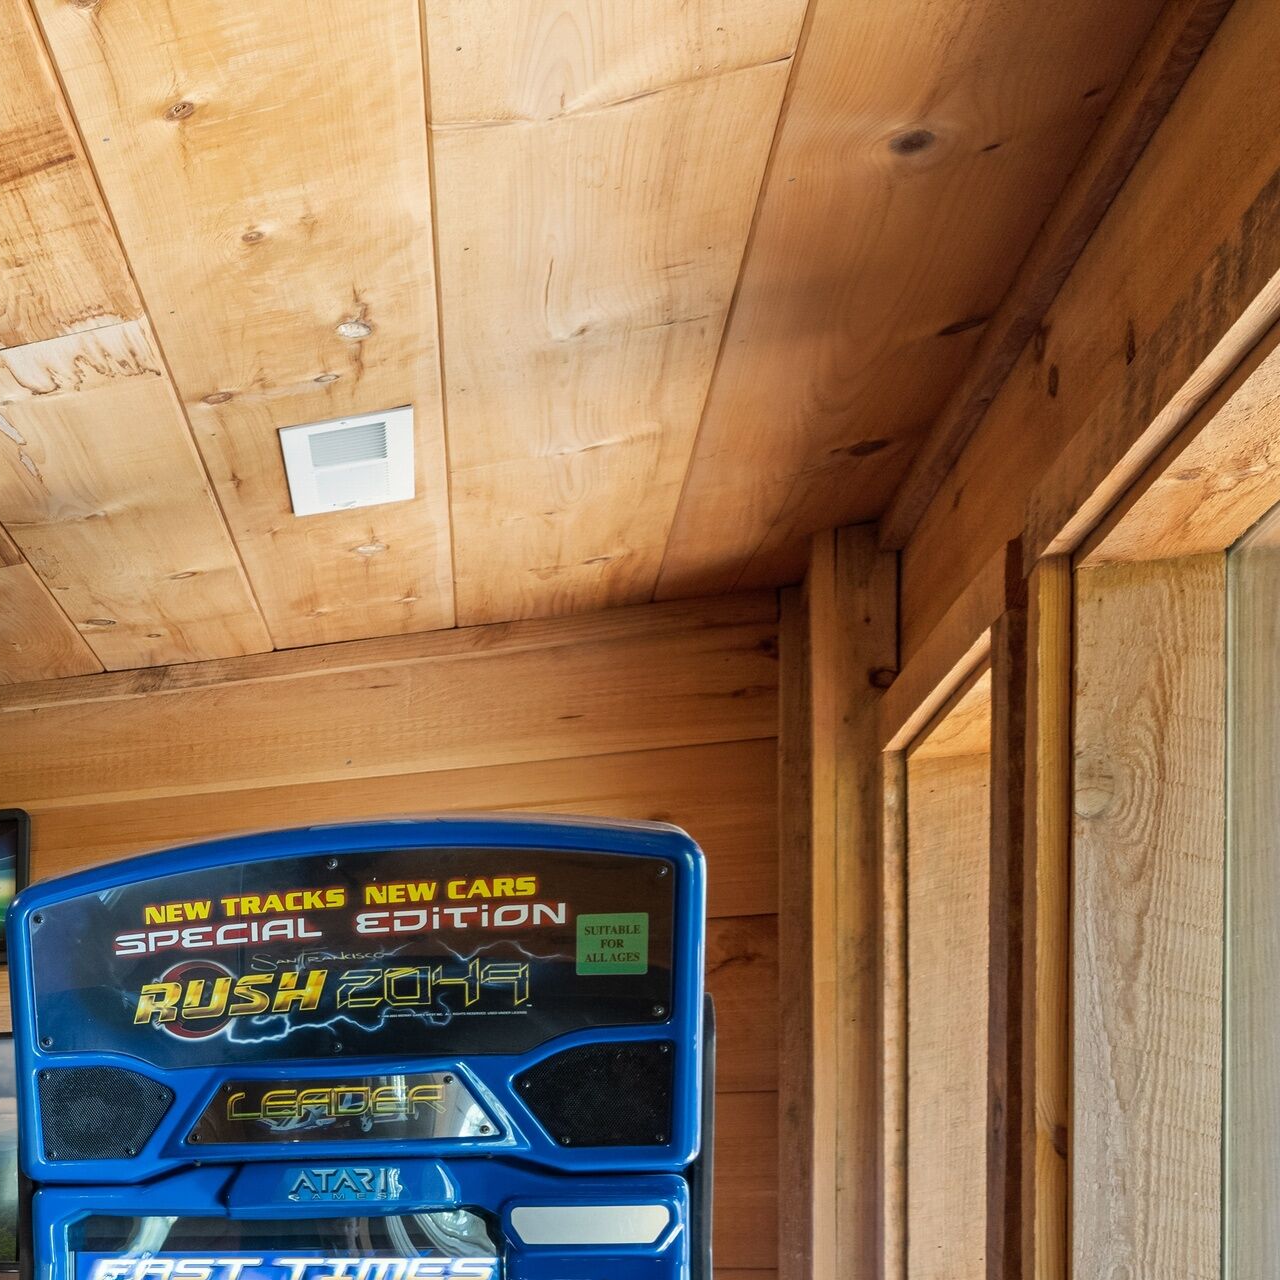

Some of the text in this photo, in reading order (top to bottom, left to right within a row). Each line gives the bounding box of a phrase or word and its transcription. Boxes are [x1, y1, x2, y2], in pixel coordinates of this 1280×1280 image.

[144, 875, 538, 926] NEW TRACKS NEW CARS
[114, 917, 322, 956] SPECIAL
[584, 925, 641, 936] SUITABLE
[600, 938, 625, 949] FOR
[585, 952, 641, 963] ALL AGES
[132, 957, 529, 1025] RUSH 2049
[226, 1082, 449, 1121] LEADER
[289, 1168, 388, 1193] ATARI
